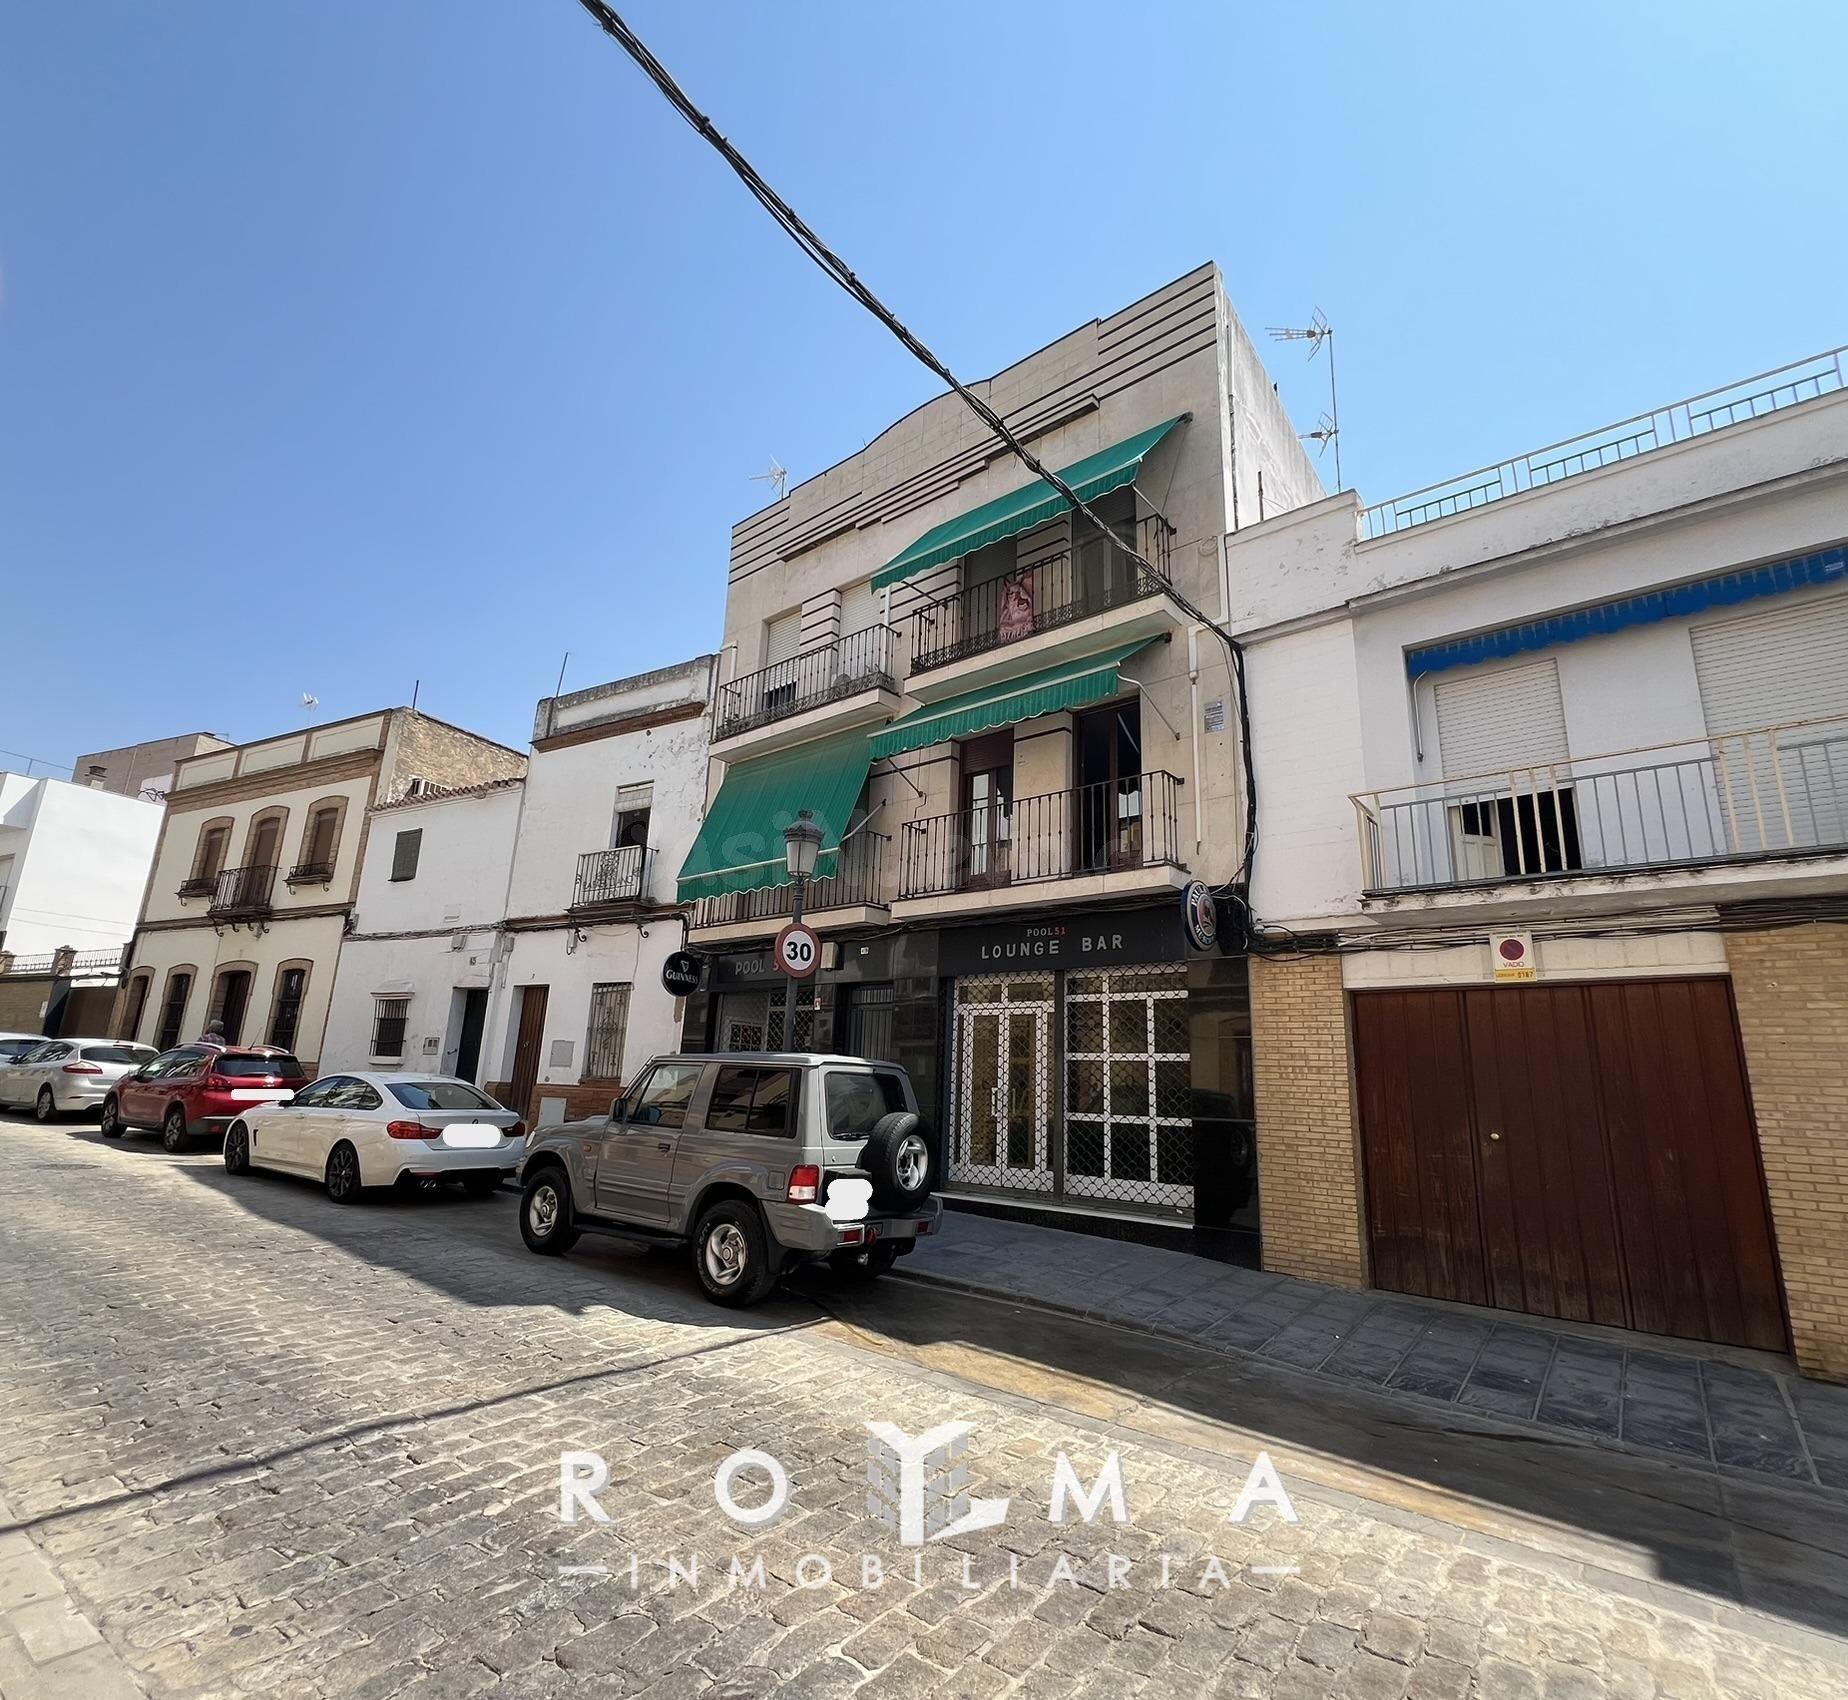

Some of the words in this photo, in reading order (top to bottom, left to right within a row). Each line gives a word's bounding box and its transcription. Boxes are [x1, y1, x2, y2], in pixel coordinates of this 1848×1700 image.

[1026, 926, 1067, 937] POOL51
[786, 941, 812, 962] 30
[981, 940, 1060, 960] LOUNGE
[1081, 934, 1123, 952] BAR
[735, 959, 765, 975] POOL
[665, 969, 699, 985] GUINNESS
